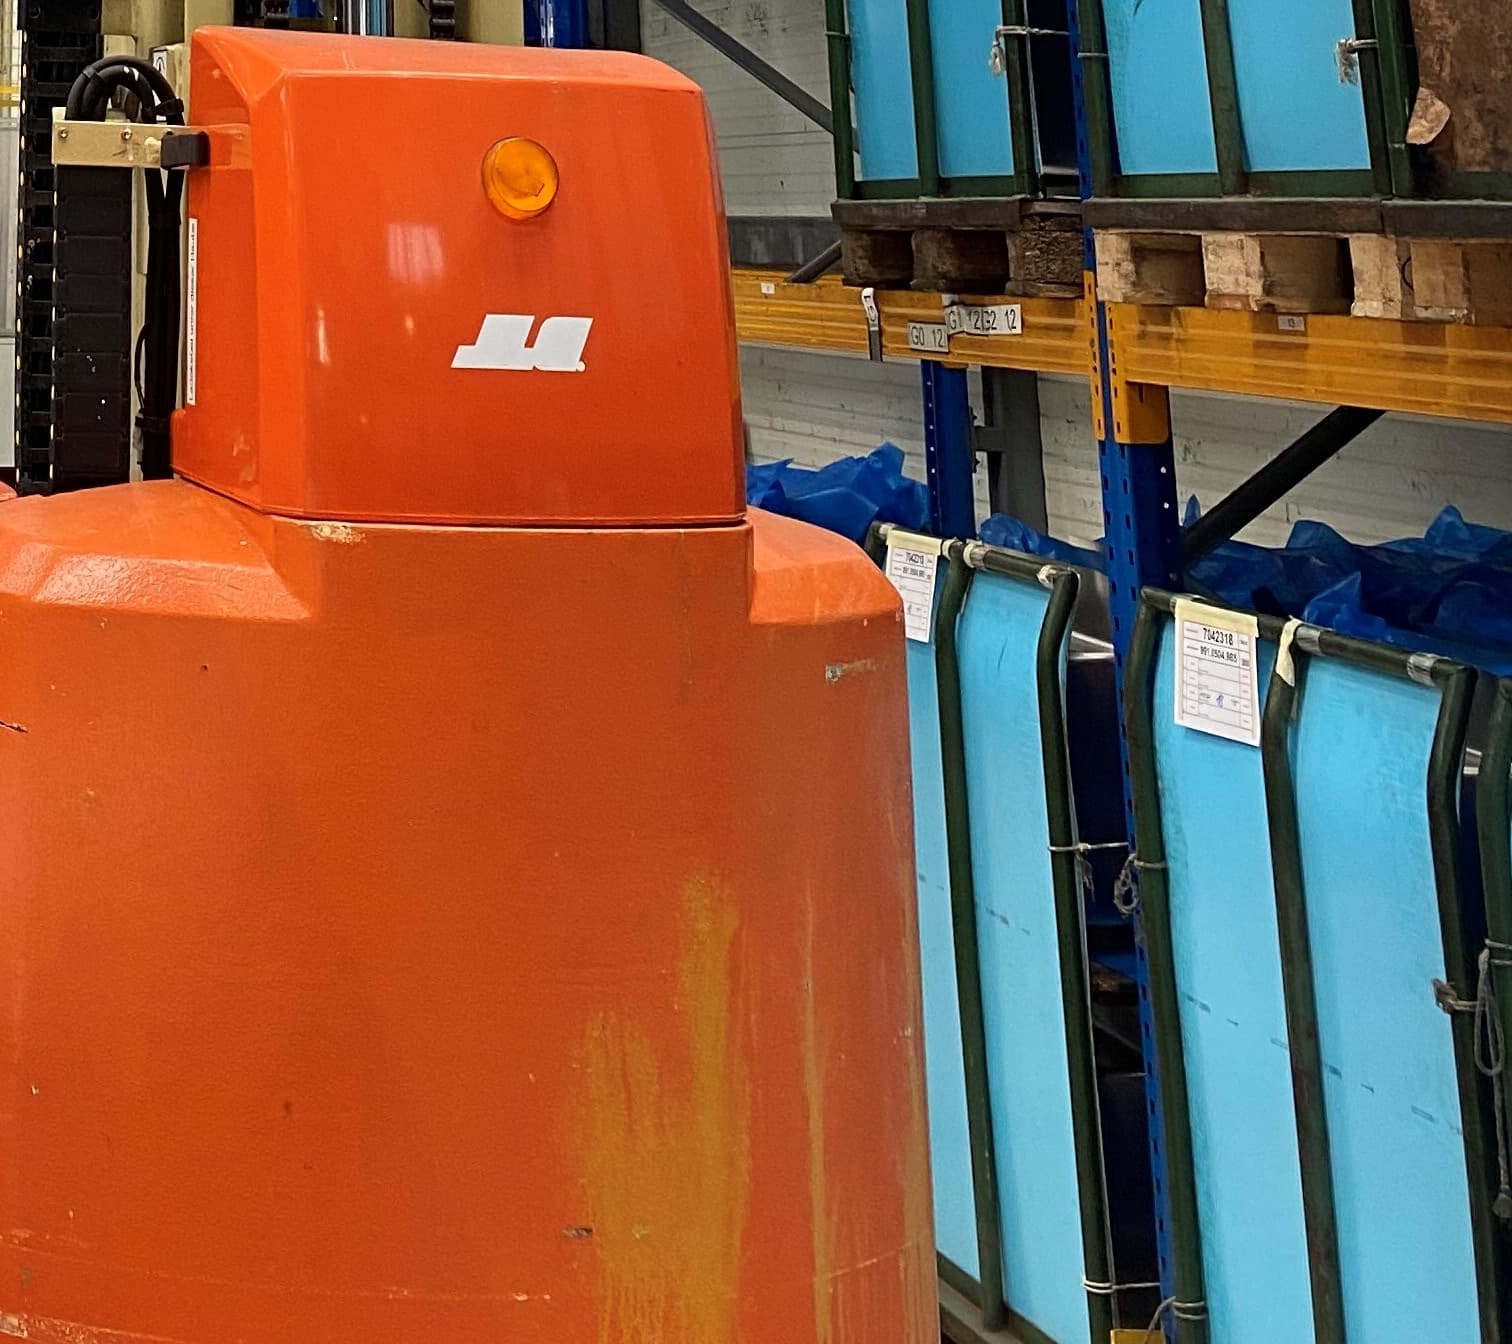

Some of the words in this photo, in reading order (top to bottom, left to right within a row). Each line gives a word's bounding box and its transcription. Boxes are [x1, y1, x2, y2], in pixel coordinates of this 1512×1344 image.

[967, 310, 981, 330] 12
[1004, 308, 1017, 330] 12
[911, 326, 925, 346] G0
[932, 328, 944, 348] 12
[1202, 627, 1233, 646] 7042318
